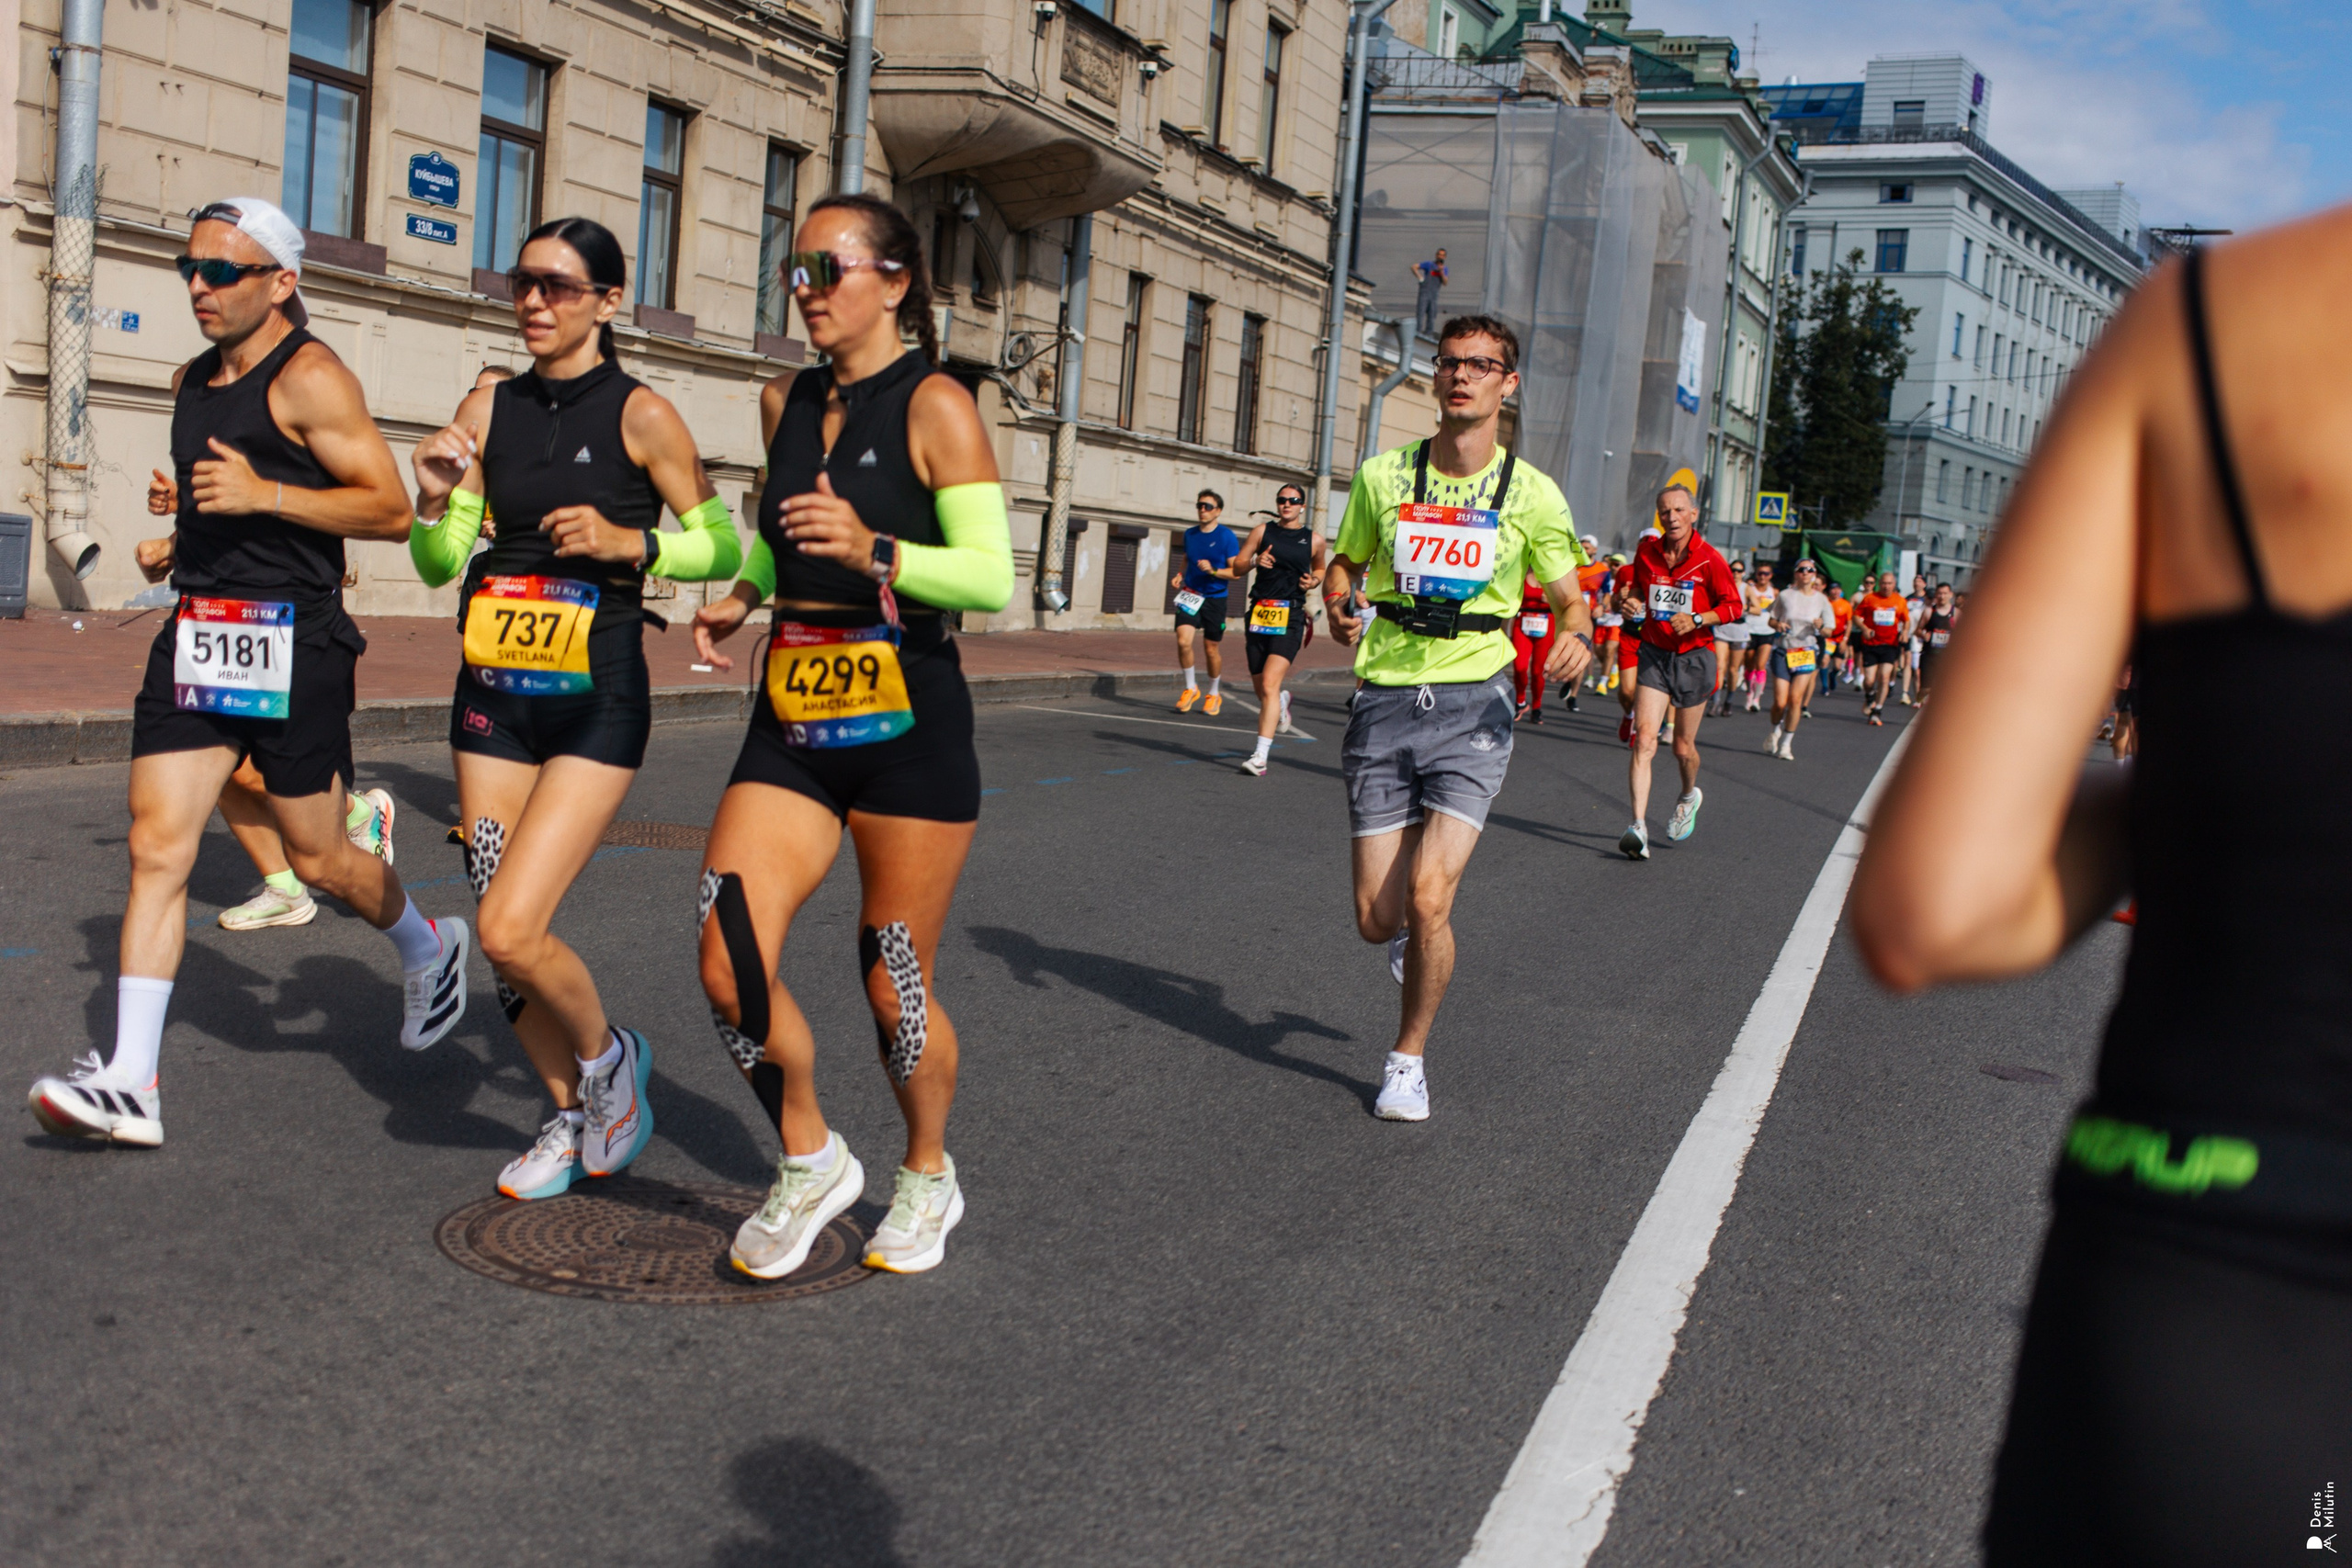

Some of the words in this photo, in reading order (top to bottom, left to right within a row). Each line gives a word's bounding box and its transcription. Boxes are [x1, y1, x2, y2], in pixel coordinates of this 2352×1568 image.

[414, 168, 454, 187] КУЙБЫШЕВА
[415, 220, 433, 236] 33/8
[1408, 535, 1481, 568] 7760
[1406, 577, 1416, 592] E
[1655, 589, 1686, 605] 6240
[241, 608, 258, 619] 21,1
[1257, 609, 1283, 621] 4791
[495, 609, 561, 649] 737
[192, 631, 269, 670] 5181
[497, 650, 555, 663] SVETLANA
[217, 670, 249, 682] ИВАН
[481, 668, 496, 686] C
[786, 654, 880, 697] 4299
[803, 694, 877, 712] АНАСТАСИЯ
